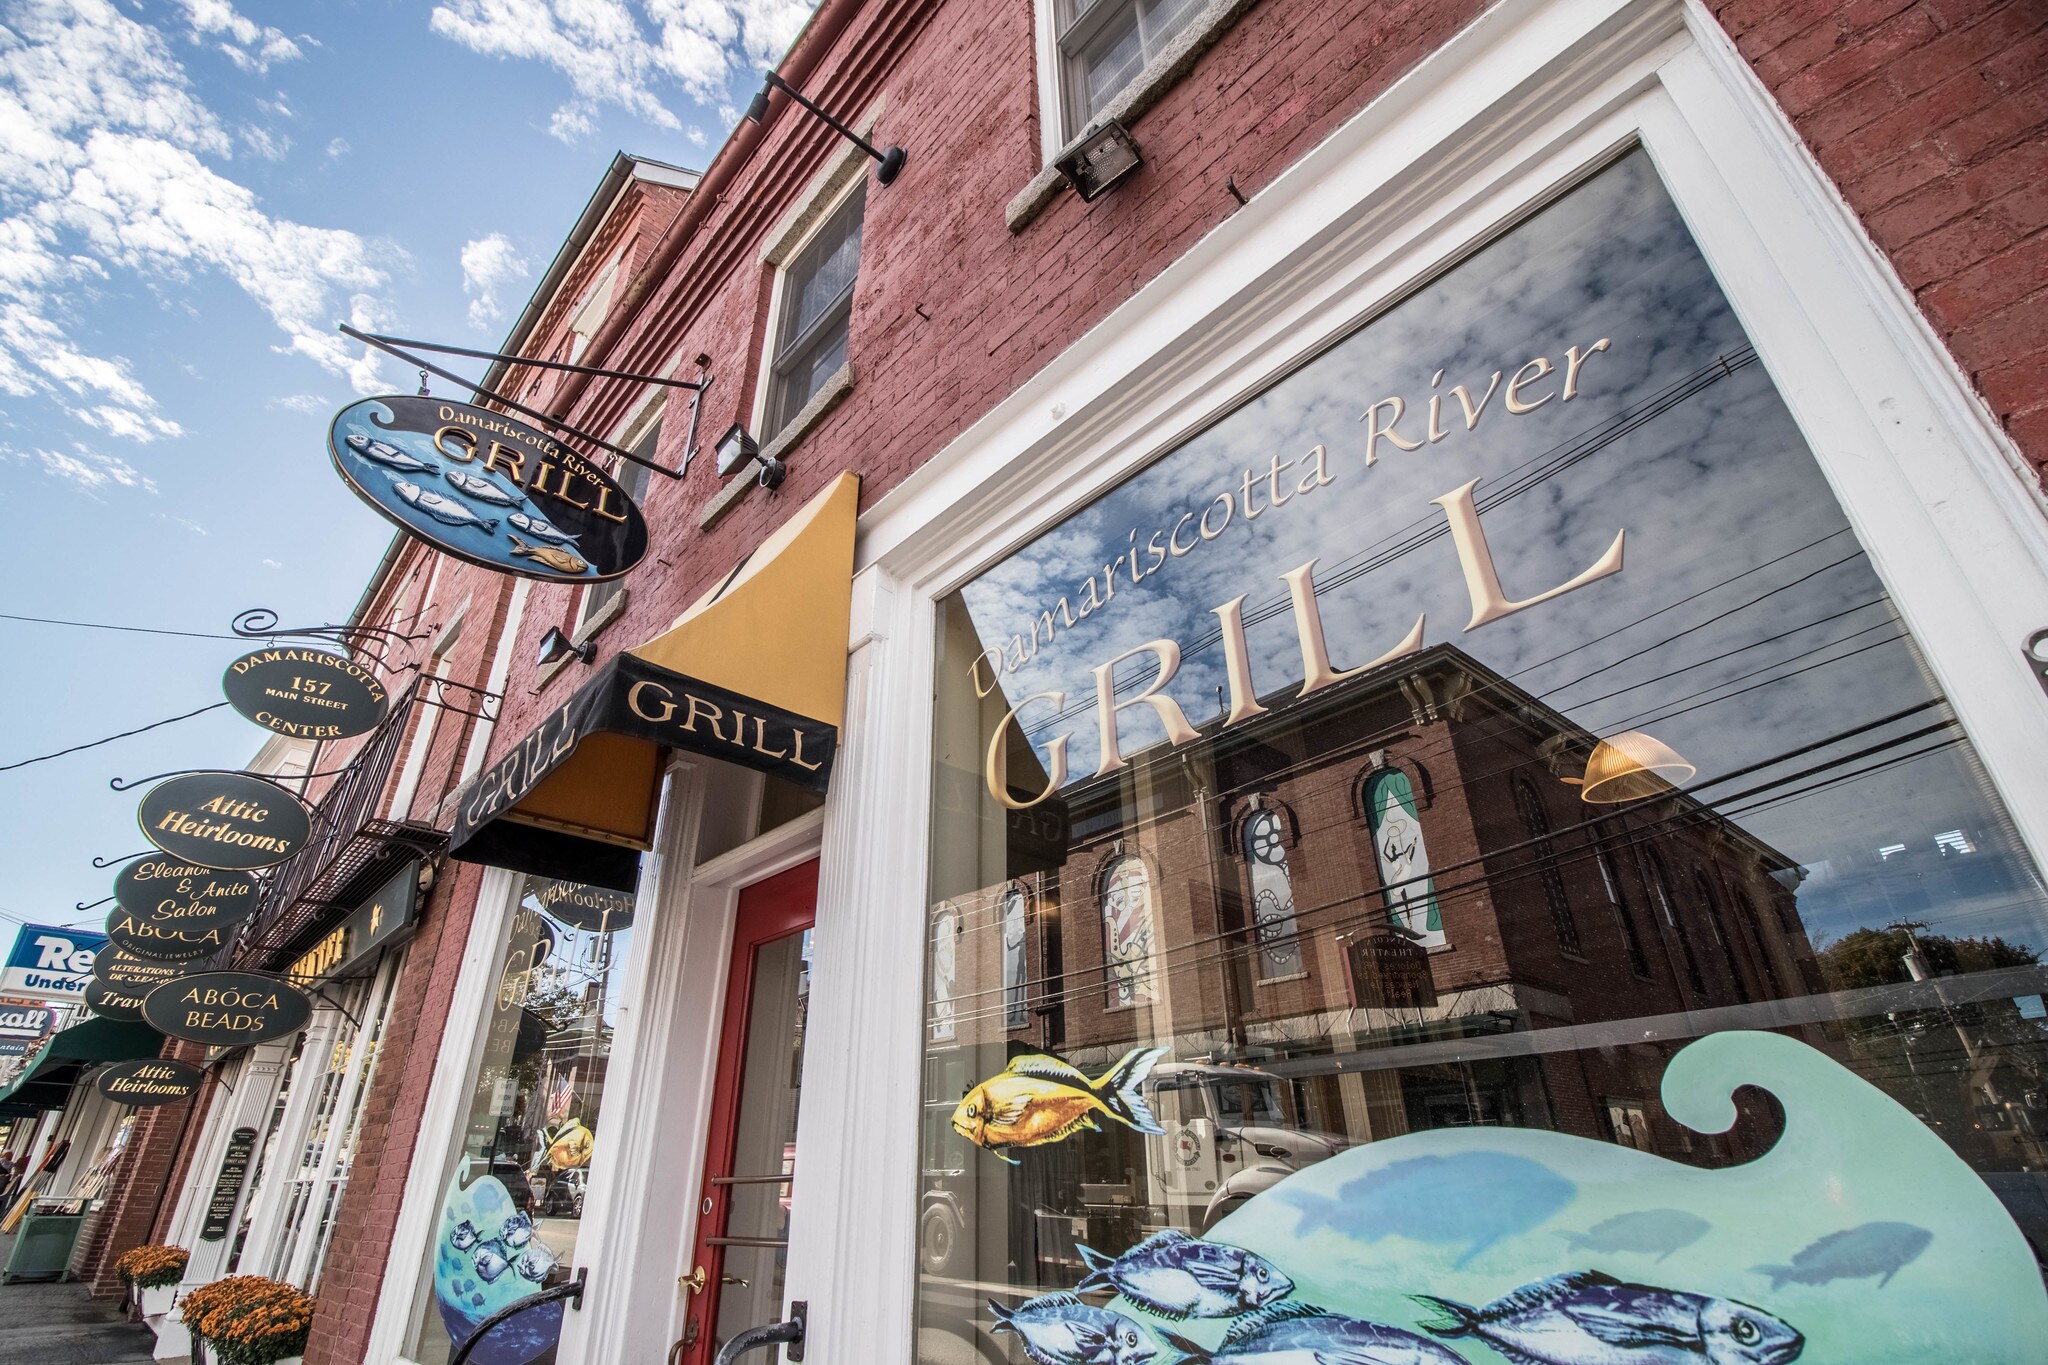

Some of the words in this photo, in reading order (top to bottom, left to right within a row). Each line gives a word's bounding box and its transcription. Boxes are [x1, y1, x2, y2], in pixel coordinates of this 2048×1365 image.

[439, 406, 559, 458] Damariscotta
[563, 453, 604, 486] River
[434, 425, 628, 525] GRILL
[966, 445, 1336, 698] Damariscotta
[1358, 337, 1612, 467] River
[985, 477, 1626, 810] GRILL
[231, 650, 385, 703] DAMARISCOTTA
[290, 676, 332, 696] 157
[265, 688, 298, 700] MAIN
[303, 696, 348, 710] STREET
[255, 711, 342, 737] CENTER
[628, 680, 823, 771] GRILL
[466, 700, 576, 826] GRILL
[197, 795, 269, 822] Attic
[155, 810, 290, 853] Heirlooms
[176, 878, 192, 893] &
[190, 881, 249, 900] Anita
[152, 900, 216, 920] Salon
[122, 939, 162, 958] ORIGINAL
[165, 949, 204, 960] JEWELRY
[109, 964, 175, 976] ALTERATIONS
[185, 1011, 265, 1032] BEADS
[132, 1064, 176, 1080] Attic
[107, 1077, 190, 1096] Heirlooms
